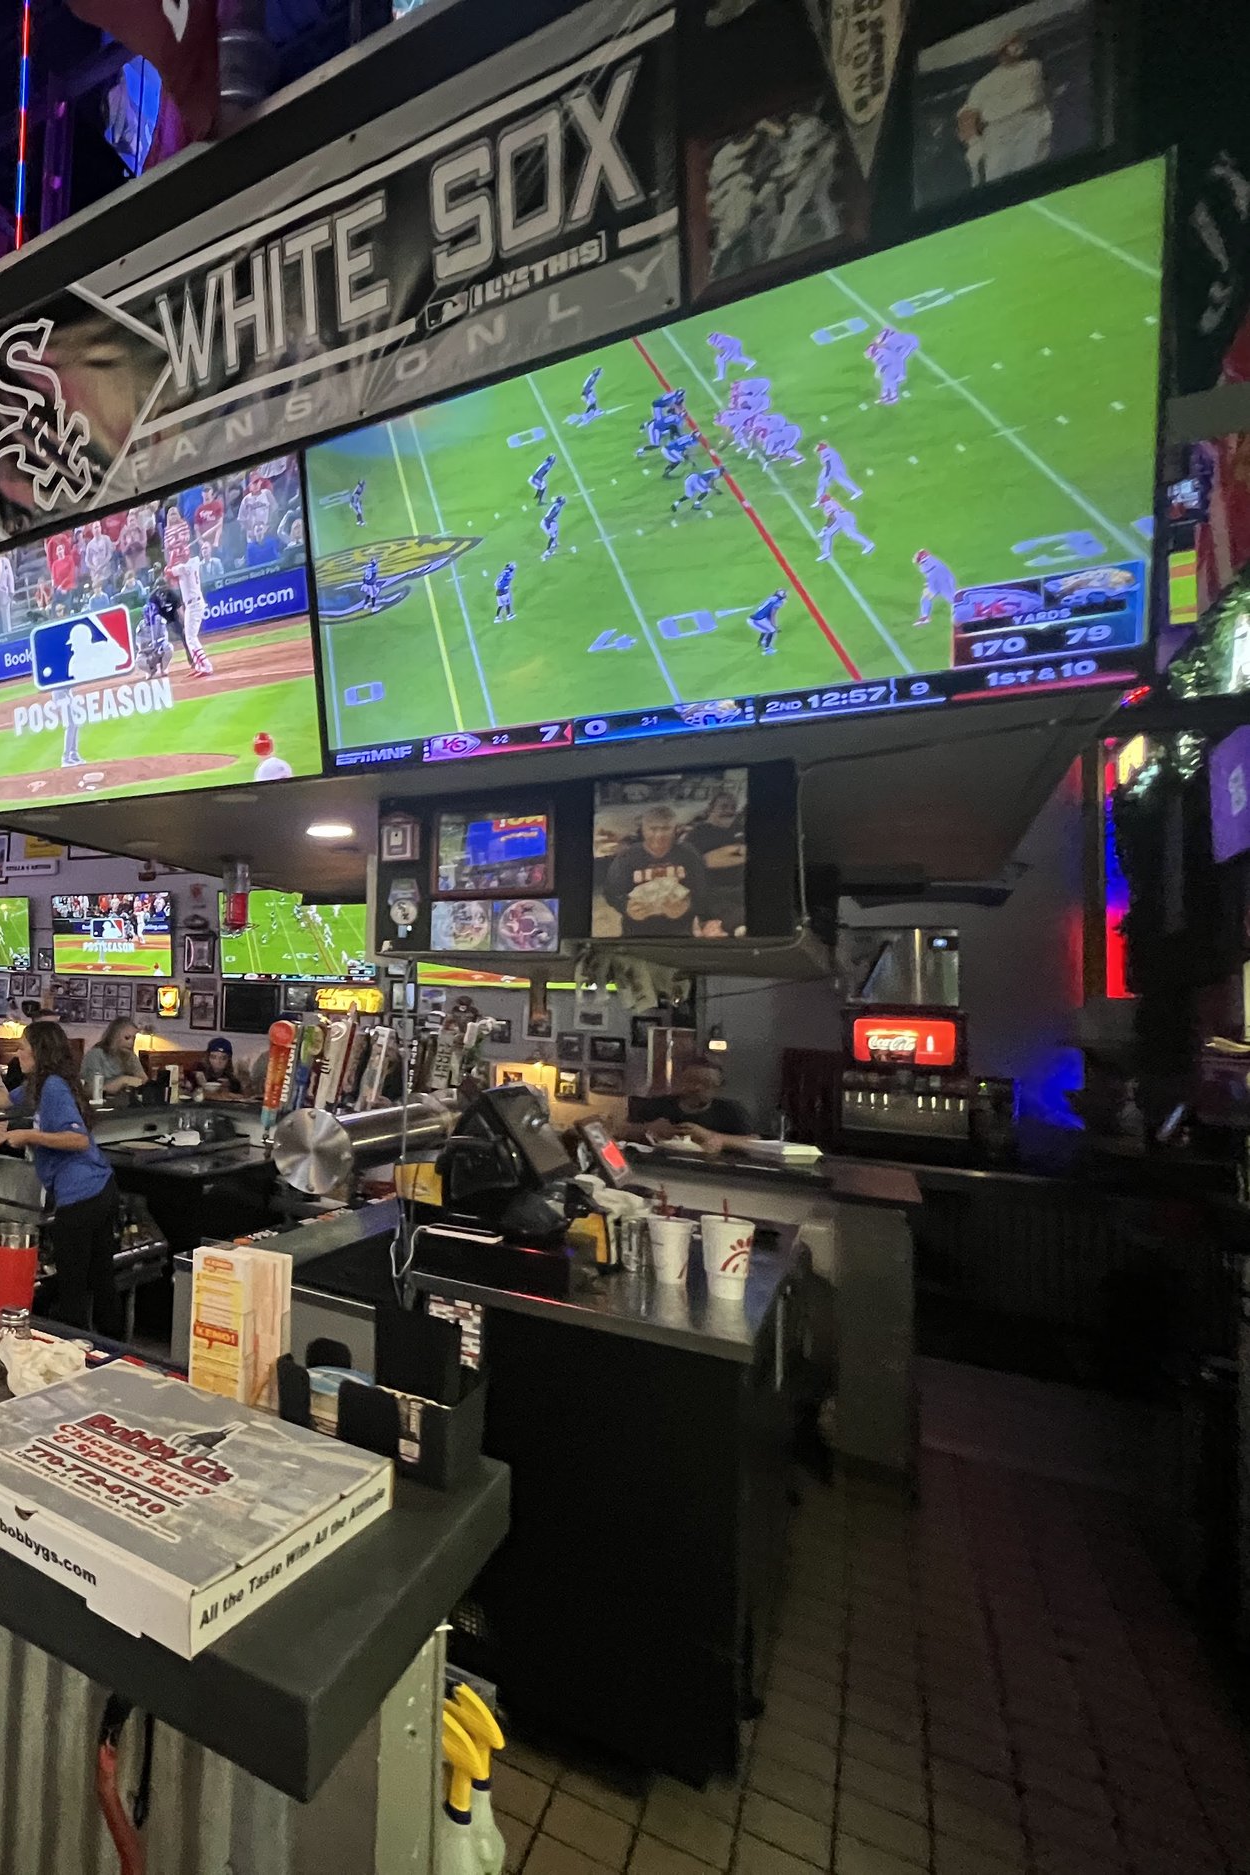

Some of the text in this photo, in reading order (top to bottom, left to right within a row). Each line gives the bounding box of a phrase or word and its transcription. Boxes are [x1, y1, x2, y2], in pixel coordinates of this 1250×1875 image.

[157, 56, 644, 398] WHITE SOX
[130, 264, 662, 484] FANS ONLY
[201, 587, 294, 621] ooking.com
[1012, 607, 1072, 625] YARDS
[970, 624, 1113, 658] 170 79
[986, 659, 1098, 687] 1ST & 10
[13, 678, 175, 735] POSTSEASON
[764, 681, 930, 714] 2ND 12:57 9
[539, 724, 561, 743] 7
[584, 718, 608, 737] 0
[82, 941, 135, 953] POSTSEASON
[59, 1424, 216, 1495] Chicago Eatery
[81, 1413, 234, 1483] Bobby G's
[52, 1434, 190, 1498] & Sports Bar
[200, 1601, 219, 1629] All
[222, 1588, 244, 1613] the
[248, 1562, 283, 1594] Taste
[285, 1541, 311, 1569] With
[312, 1526, 329, 1548] All
[330, 1515, 347, 1536] the
